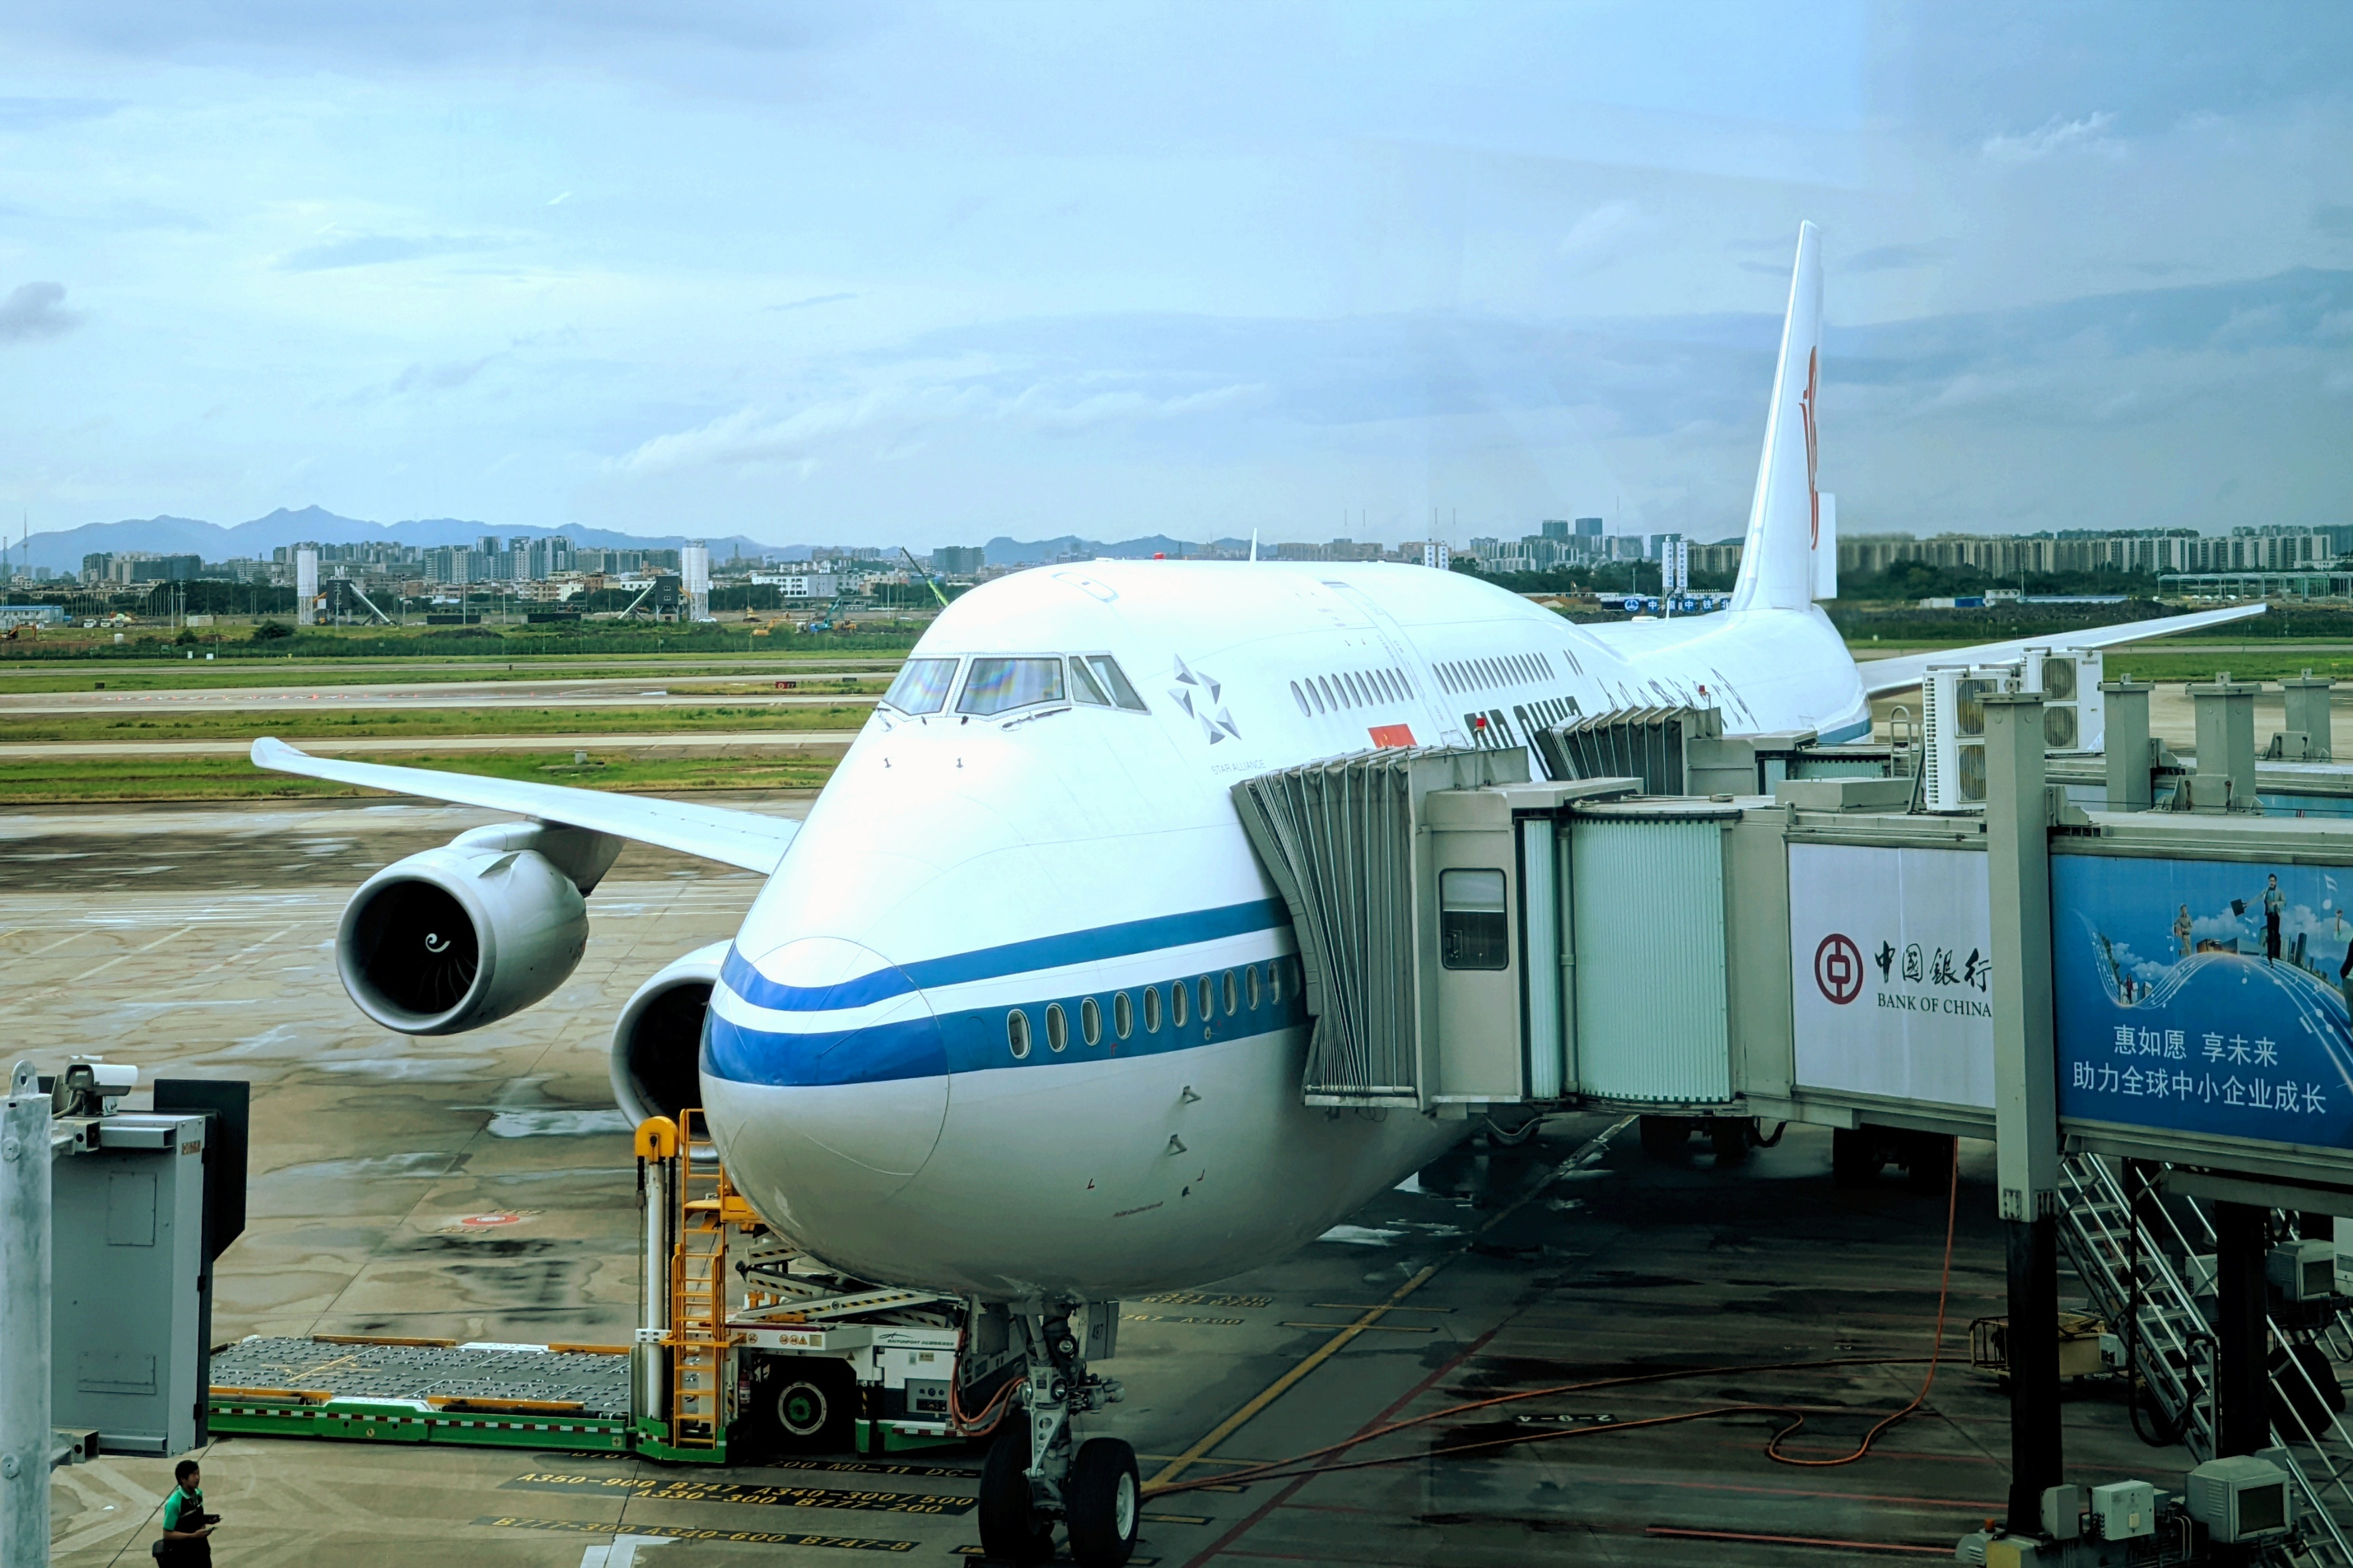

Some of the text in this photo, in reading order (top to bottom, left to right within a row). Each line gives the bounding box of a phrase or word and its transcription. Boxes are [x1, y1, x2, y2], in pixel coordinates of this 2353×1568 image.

[1211, 759, 1266, 775] STAR ALLIANCE
[1878, 993, 1992, 1017] BANK OF CHINA
[2114, 1024, 2278, 1067] 惠如愿 享未来
[2073, 1061, 2327, 1114] 助力全球中小企业成长
[827, 1462, 911, 1474] MD-11
[925, 1468, 977, 1477] DC-
[516, 1472, 975, 1506] A350-900 B747 A340-300/500
[632, 1489, 943, 1513] A330-300 B777-200
[493, 1517, 912, 1551] B777-300 A340-600 B747-8
